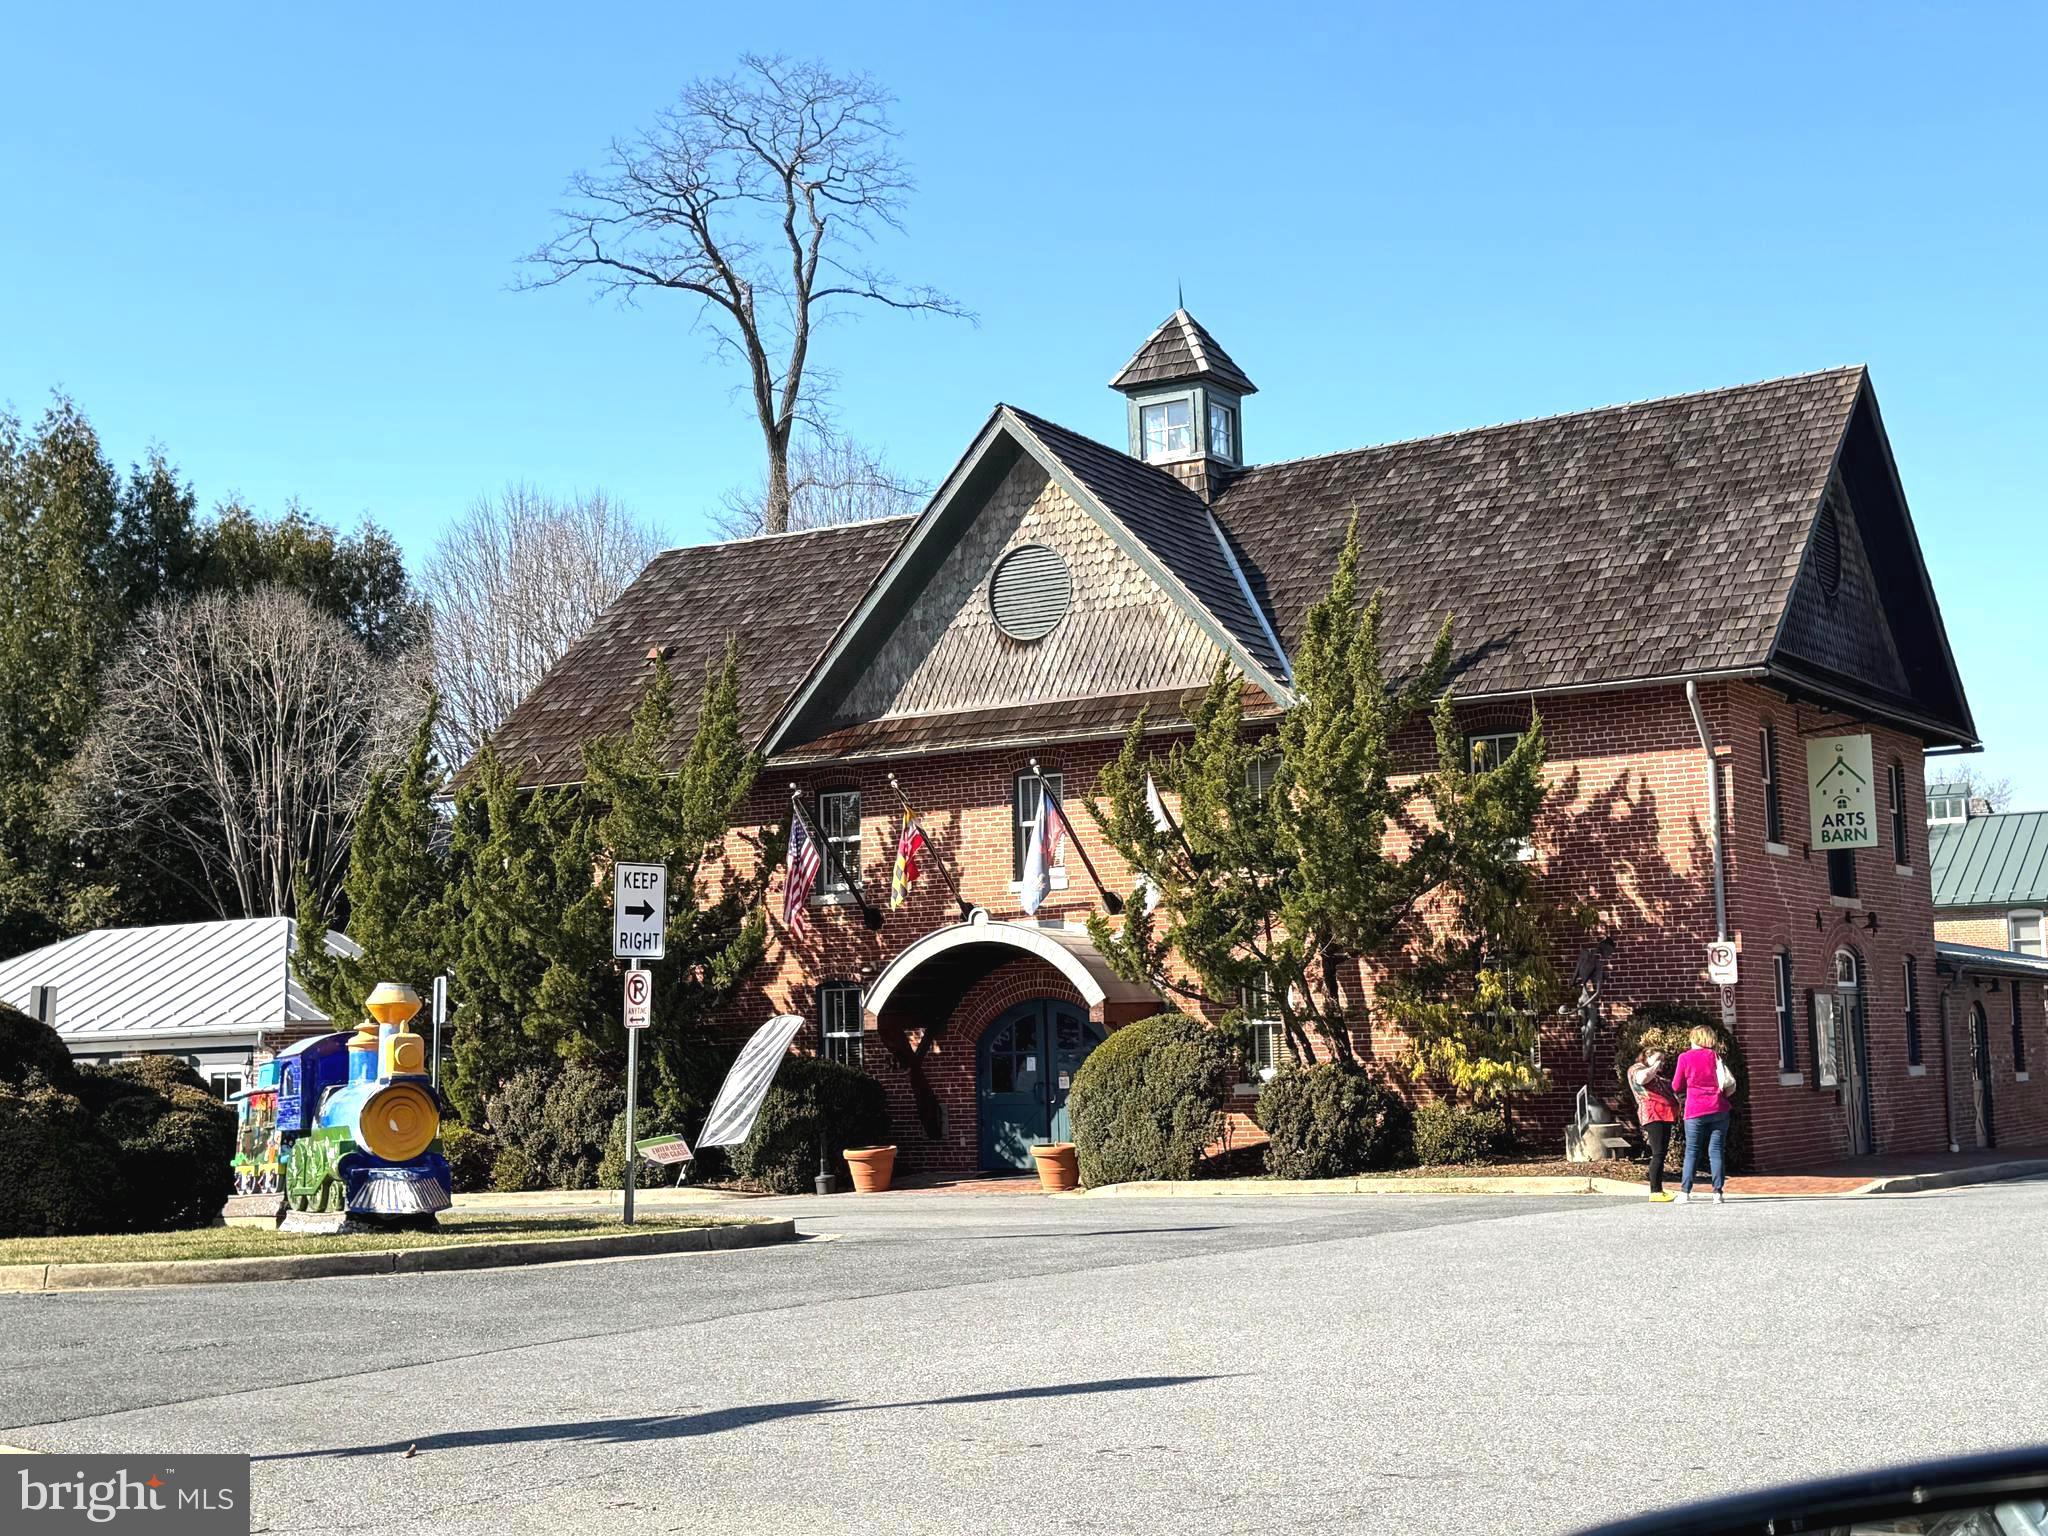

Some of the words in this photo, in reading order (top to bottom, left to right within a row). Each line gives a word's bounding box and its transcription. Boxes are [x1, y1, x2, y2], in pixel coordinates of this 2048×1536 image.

[1821, 811, 1866, 828] ARTS
[1821, 827, 1867, 843] BARN
[624, 871, 658, 889] KEEP
[620, 932, 660, 951] RIGHT
